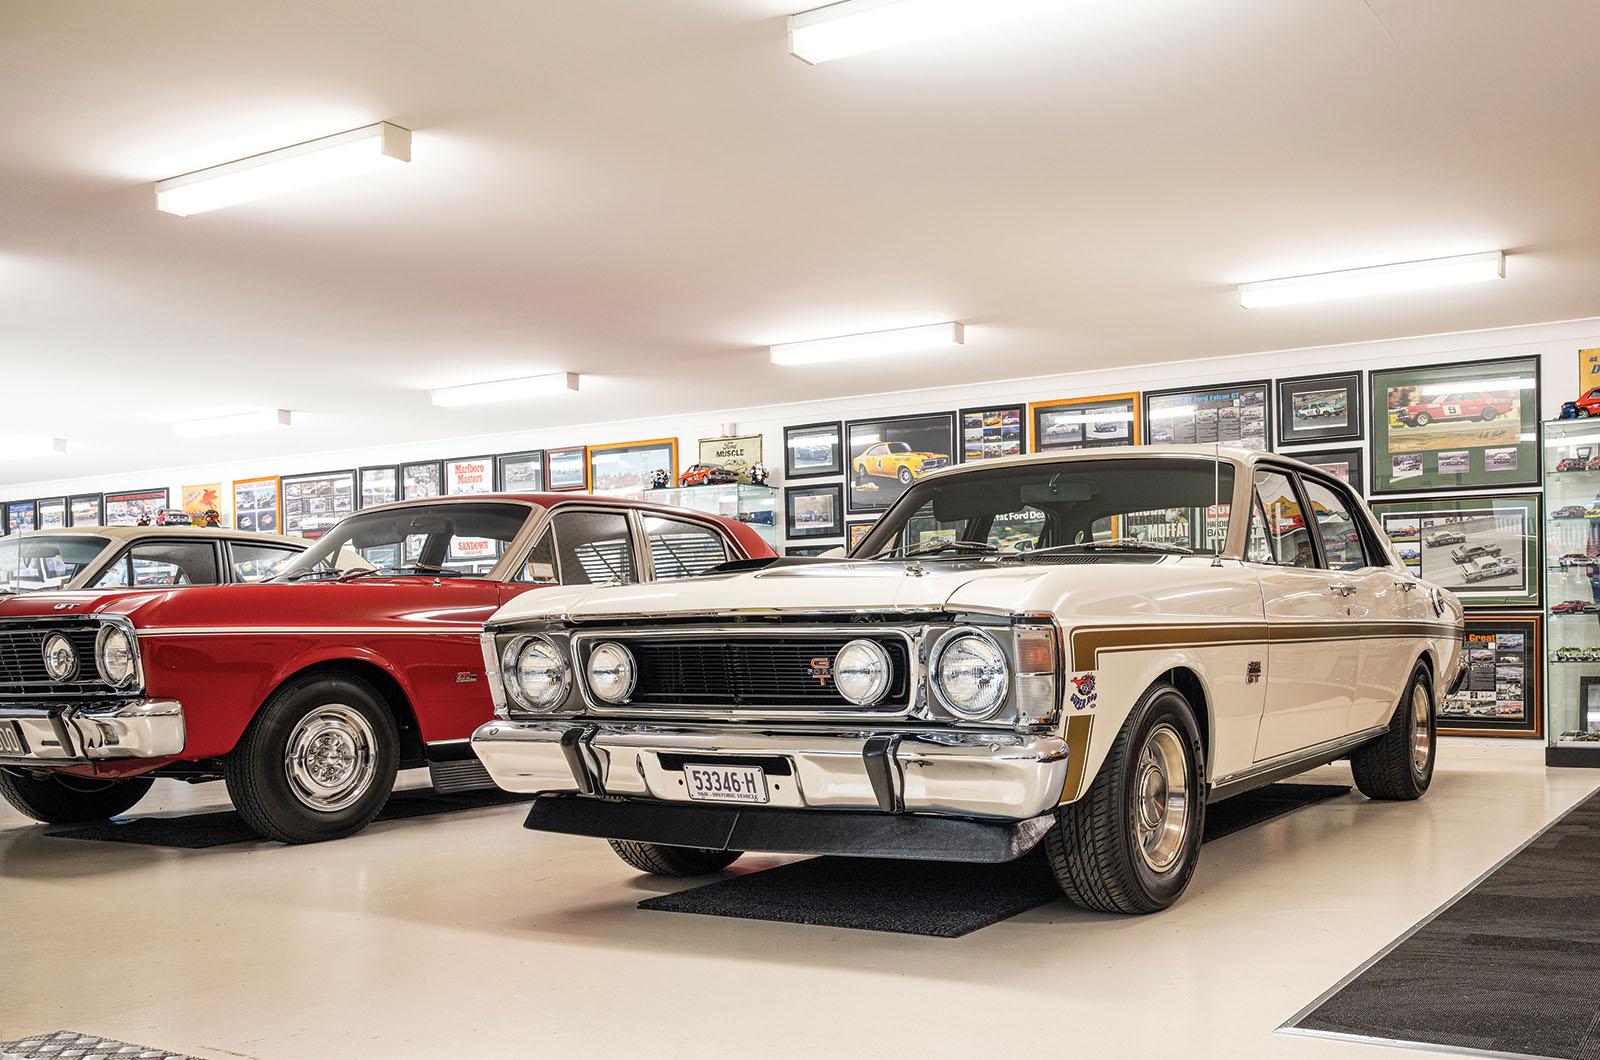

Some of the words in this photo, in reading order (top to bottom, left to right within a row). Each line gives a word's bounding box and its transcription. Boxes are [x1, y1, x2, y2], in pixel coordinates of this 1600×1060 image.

[1209, 393, 1230, 401] Falcon
[1231, 392, 1239, 400] GT
[1448, 406, 1456, 414] 9
[716, 449, 744, 458] MUSCLE
[455, 463, 484, 474] Marlboro
[457, 474, 484, 484] Masters
[1009, 511, 1028, 520] Ford
[1148, 523, 1189, 538] MOFFAT
[458, 541, 488, 551] SANDOWN
[1469, 633, 1495, 642] Great
[1070, 693, 1087, 711] SUPER
[1086, 692, 1098, 706] ROO
[712, 791, 736, 799] HISTORIC
[736, 793, 758, 801] VEHICLE
